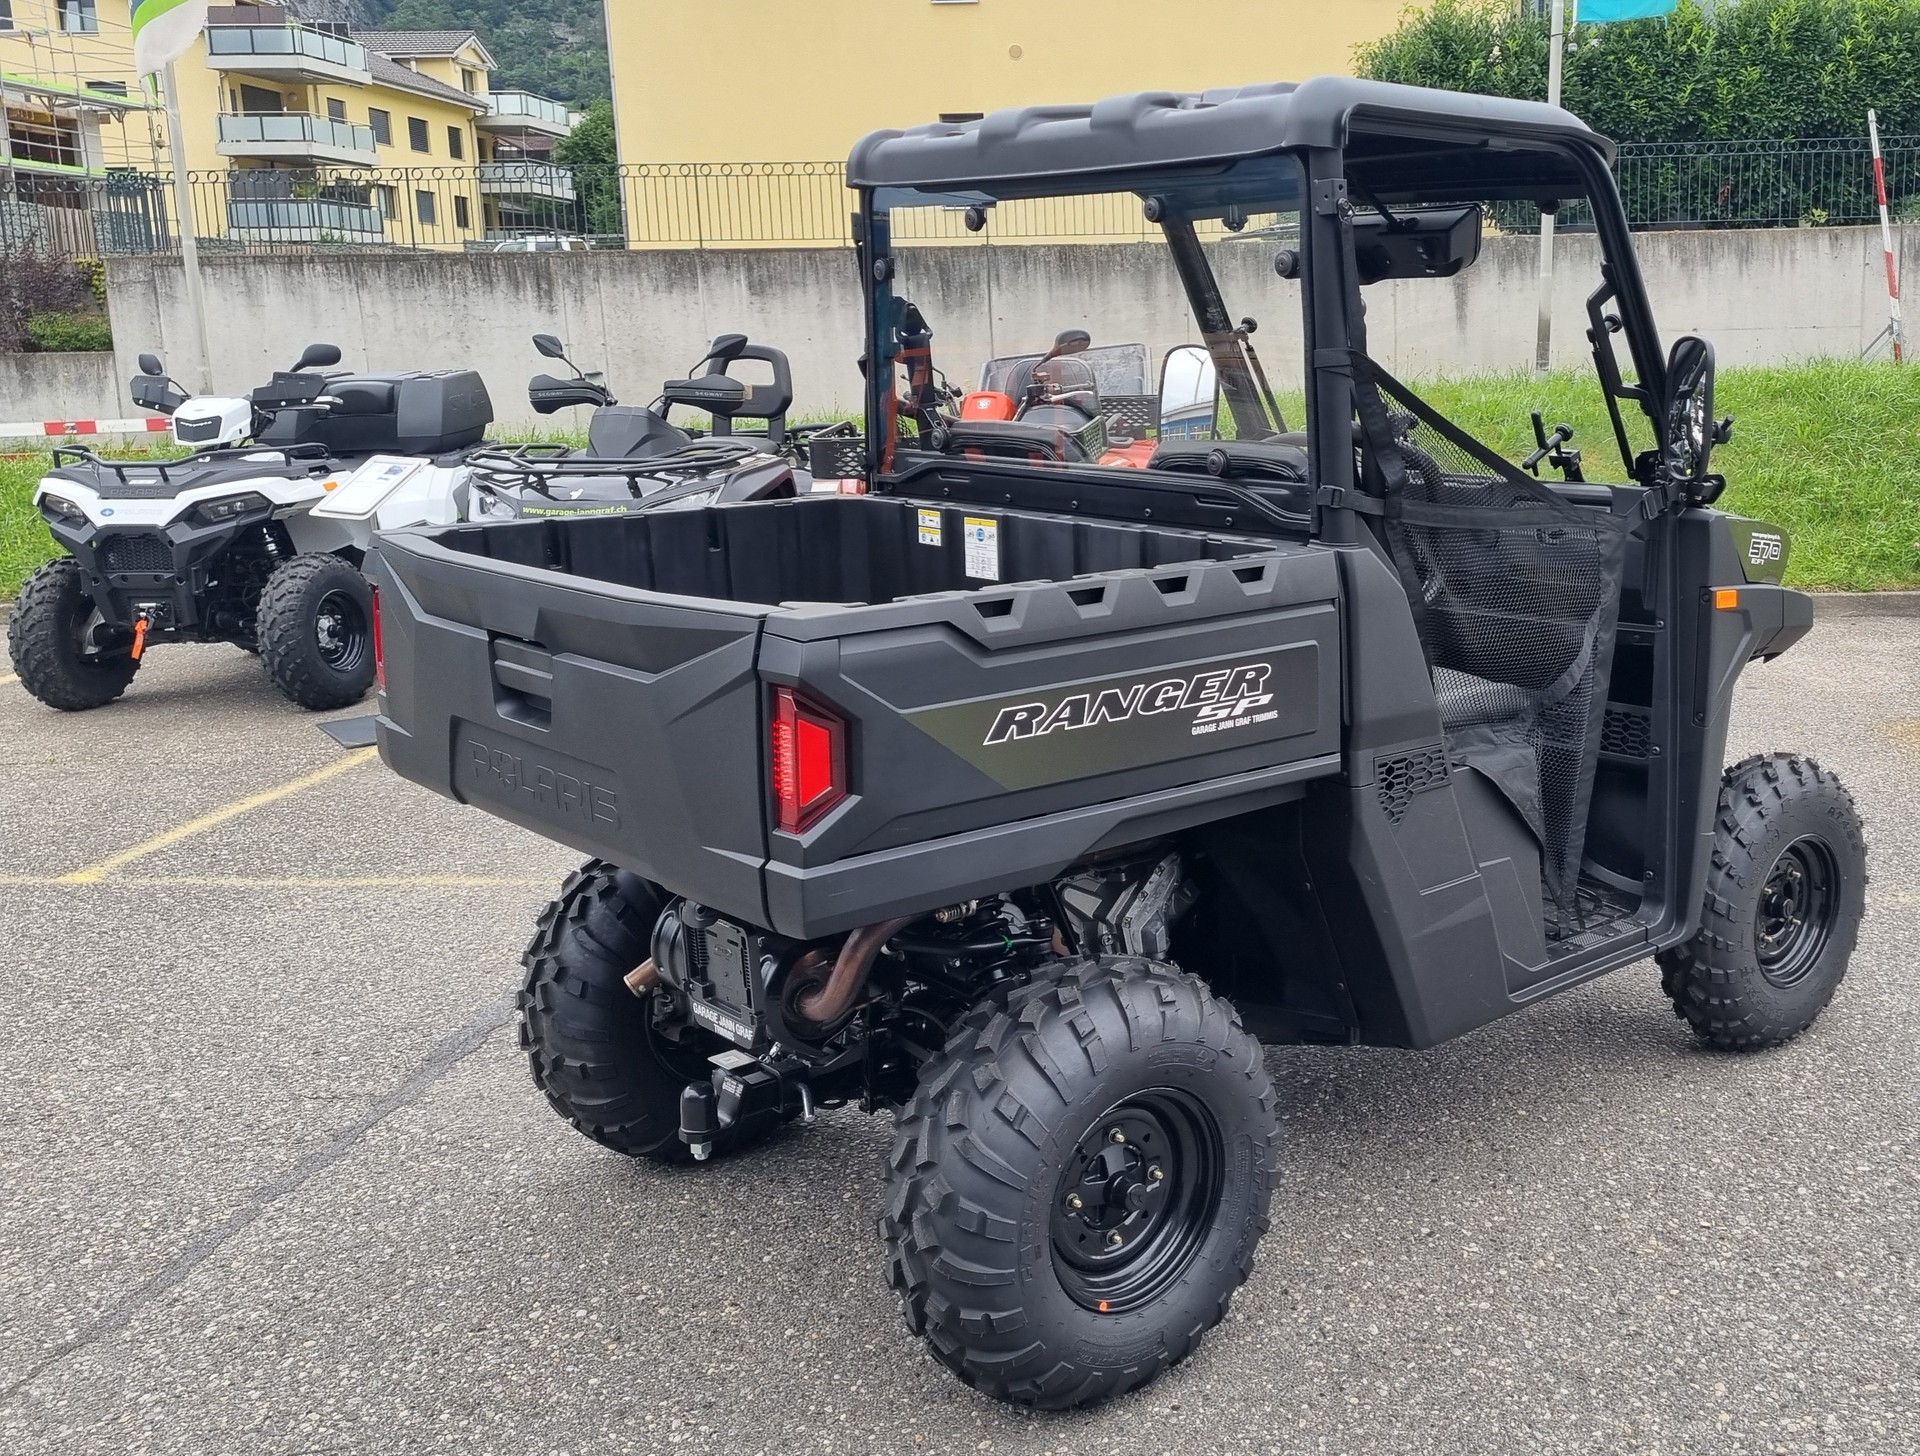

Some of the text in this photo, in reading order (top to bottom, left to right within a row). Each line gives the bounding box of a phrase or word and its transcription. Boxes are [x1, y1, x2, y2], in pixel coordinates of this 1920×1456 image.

[110, 488, 167, 496] POLARIS
[1748, 538, 1781, 560] 570
[983, 663, 1271, 745] RANGER
[1192, 693, 1274, 724] SP
[1191, 710, 1278, 736] GARAGE JANN GRAF TRIMMIS
[468, 740, 622, 832] POLARIS
[692, 1002, 753, 1041] GARAGE JANN GRAF
